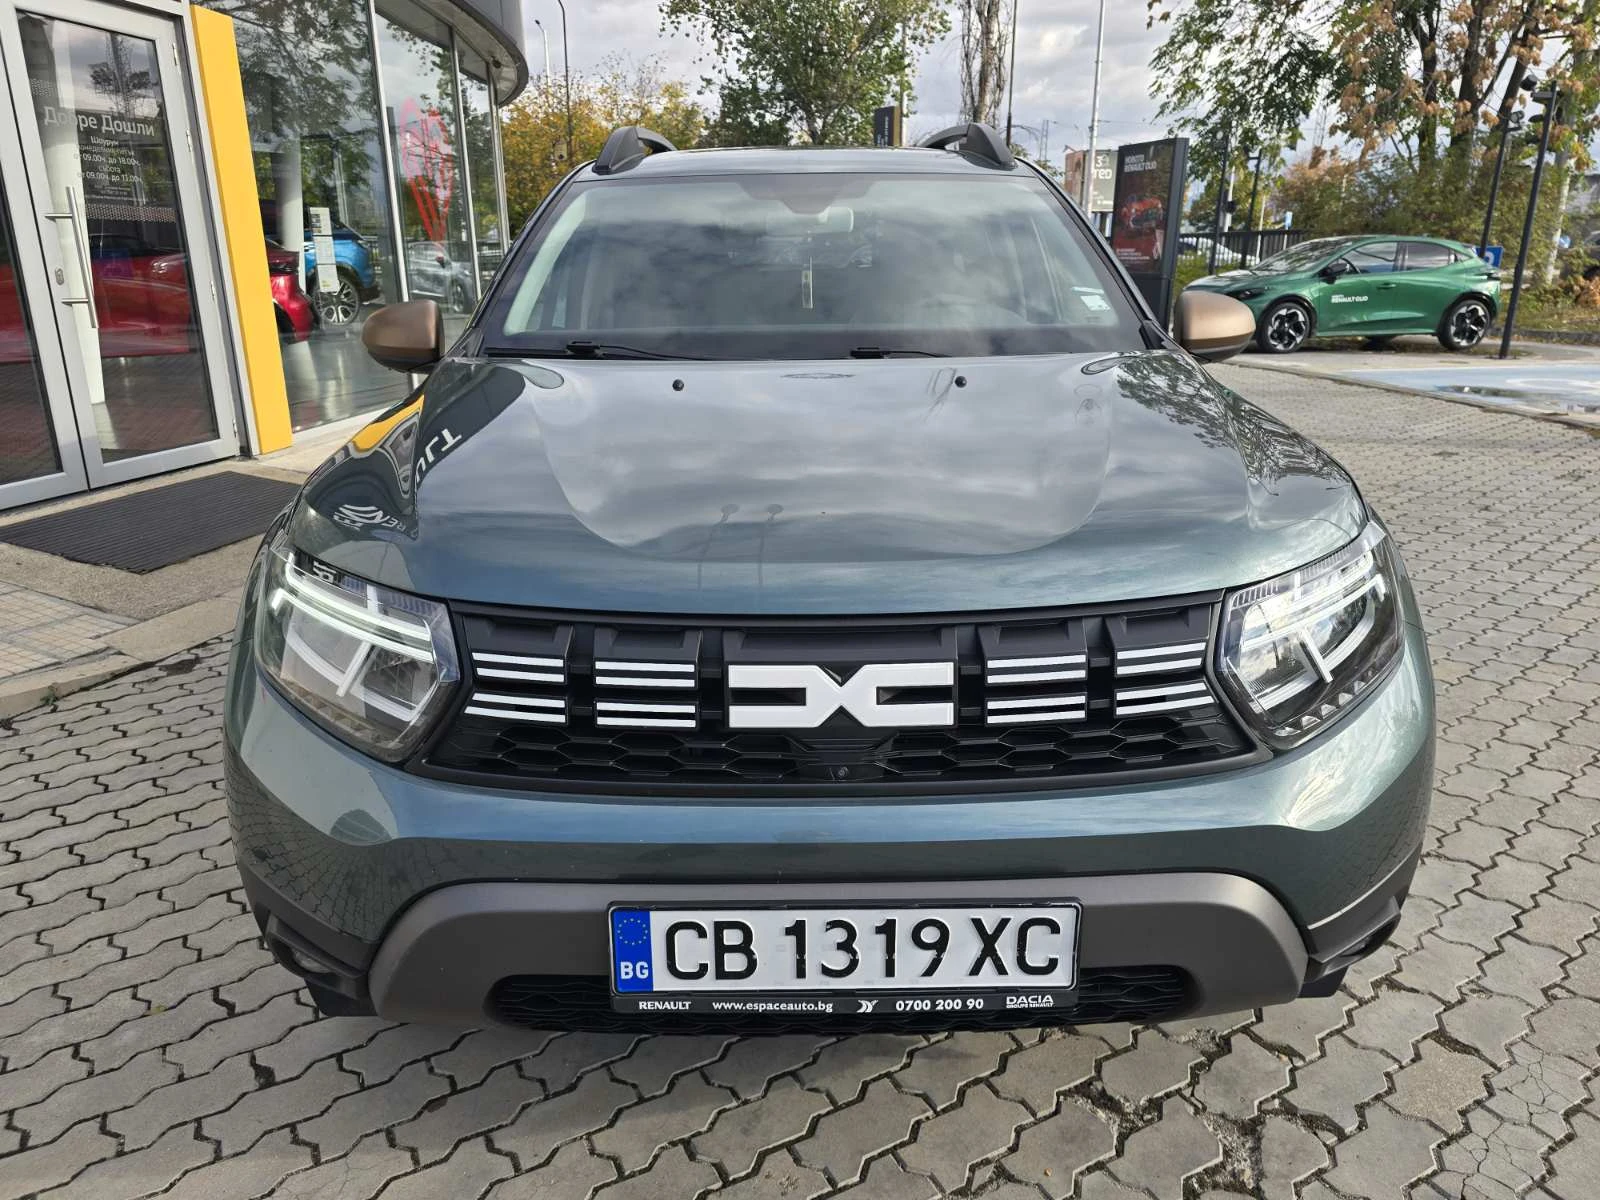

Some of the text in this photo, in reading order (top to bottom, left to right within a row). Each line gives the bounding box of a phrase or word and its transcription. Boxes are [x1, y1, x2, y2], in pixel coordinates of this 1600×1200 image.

[101, 114, 155, 136] Дошли
[785, 918, 950, 980] 1319
[620, 961, 649, 980] BG
[638, 998, 984, 1013] RENAULT www.espaceauto.bg 0700 200 90
[1006, 995, 1054, 1005] DACIA
